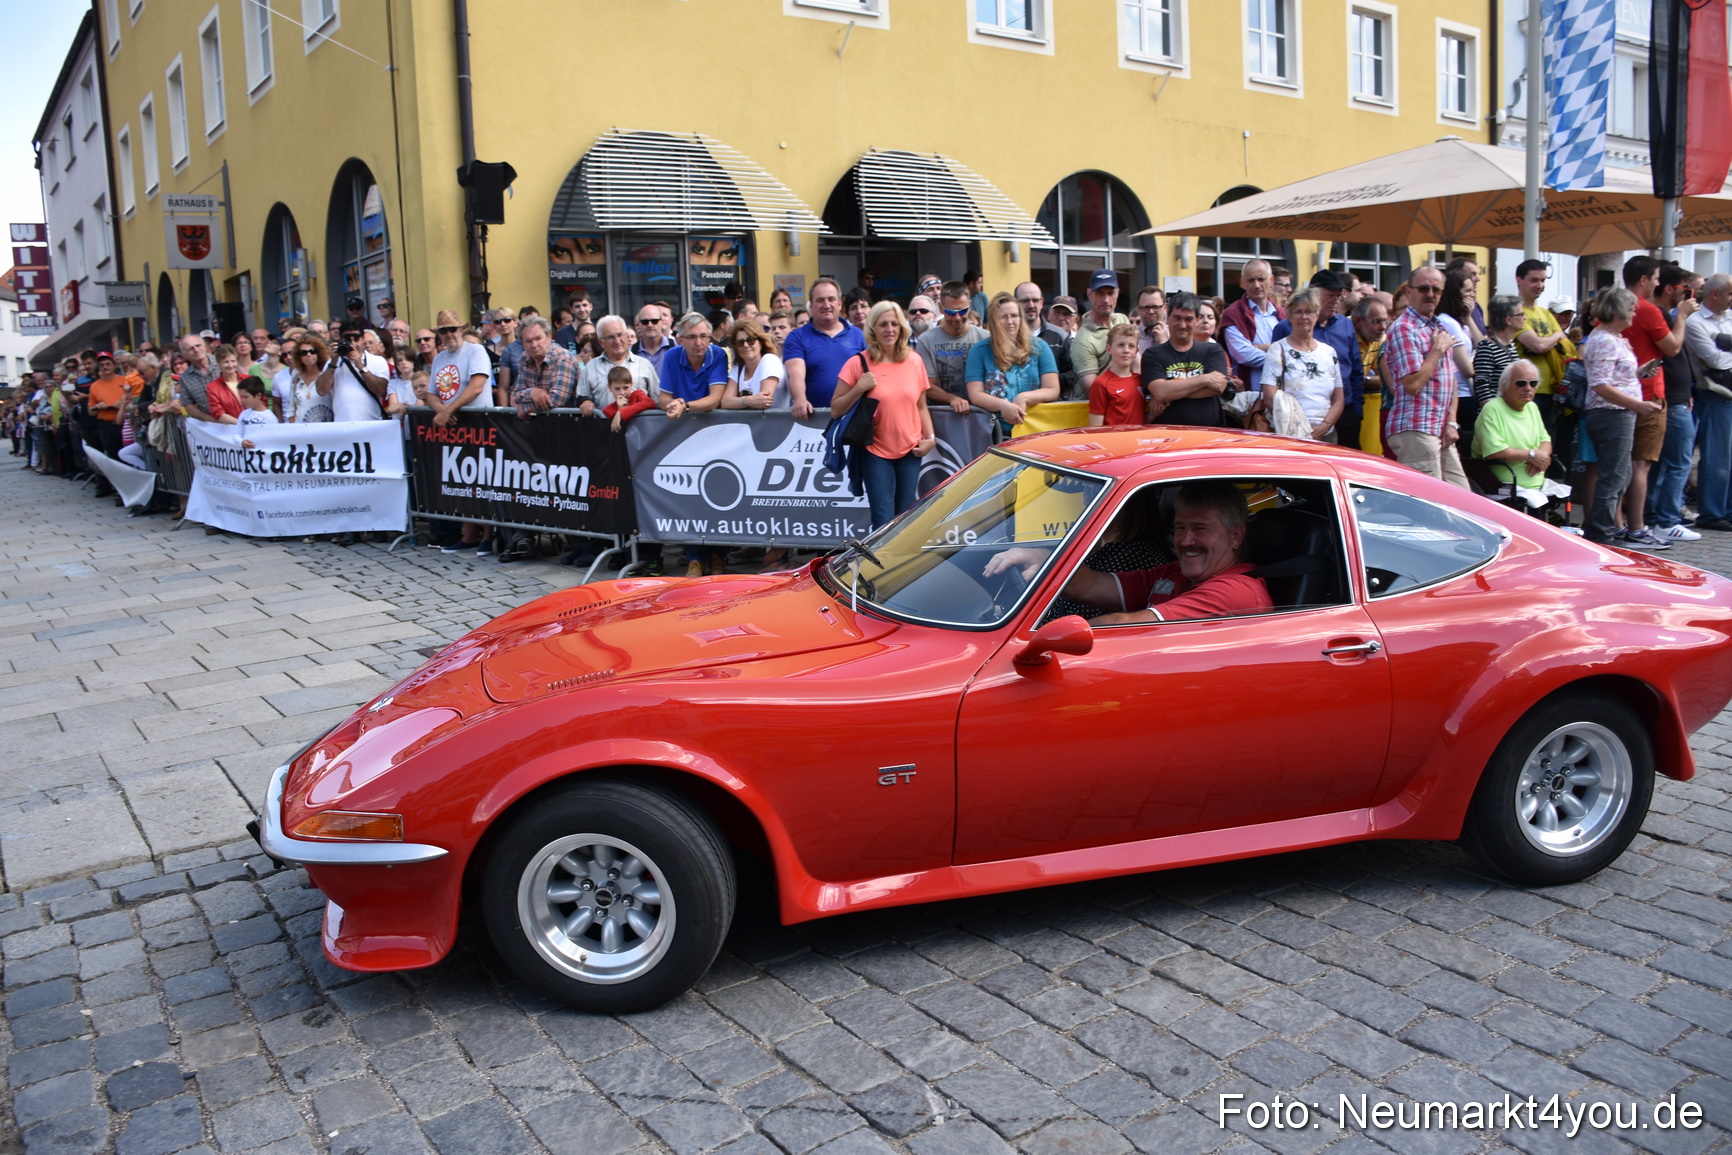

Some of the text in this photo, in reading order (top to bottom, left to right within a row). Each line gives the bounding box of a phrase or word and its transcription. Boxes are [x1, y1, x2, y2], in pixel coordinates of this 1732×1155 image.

[168, 199, 207, 208] RATHAUS
[11, 224, 41, 311] WITT
[550, 270, 599, 279] Digitale Bilder
[701, 271, 734, 279] Passbilder
[691, 284, 726, 293] Bewerbung
[20, 316, 53, 327] WITT
[934, 342, 962, 352] UNCLE
[417, 425, 497, 446] FAHRSCHULE
[789, 438, 825, 453] Aut
[441, 445, 620, 500] Kohlmann GmbH
[757, 457, 852, 494] Die
[274, 479, 294, 491] FÜR
[441, 484, 473, 498] Neumarkt
[515, 491, 550, 508] Freystadt
[553, 496, 590, 512] Pyrbaum
[751, 498, 829, 508] BREITENBRUNN
[265, 504, 372, 519] facebook.com/neumarktaktuell
[878, 771, 917, 786] GT
